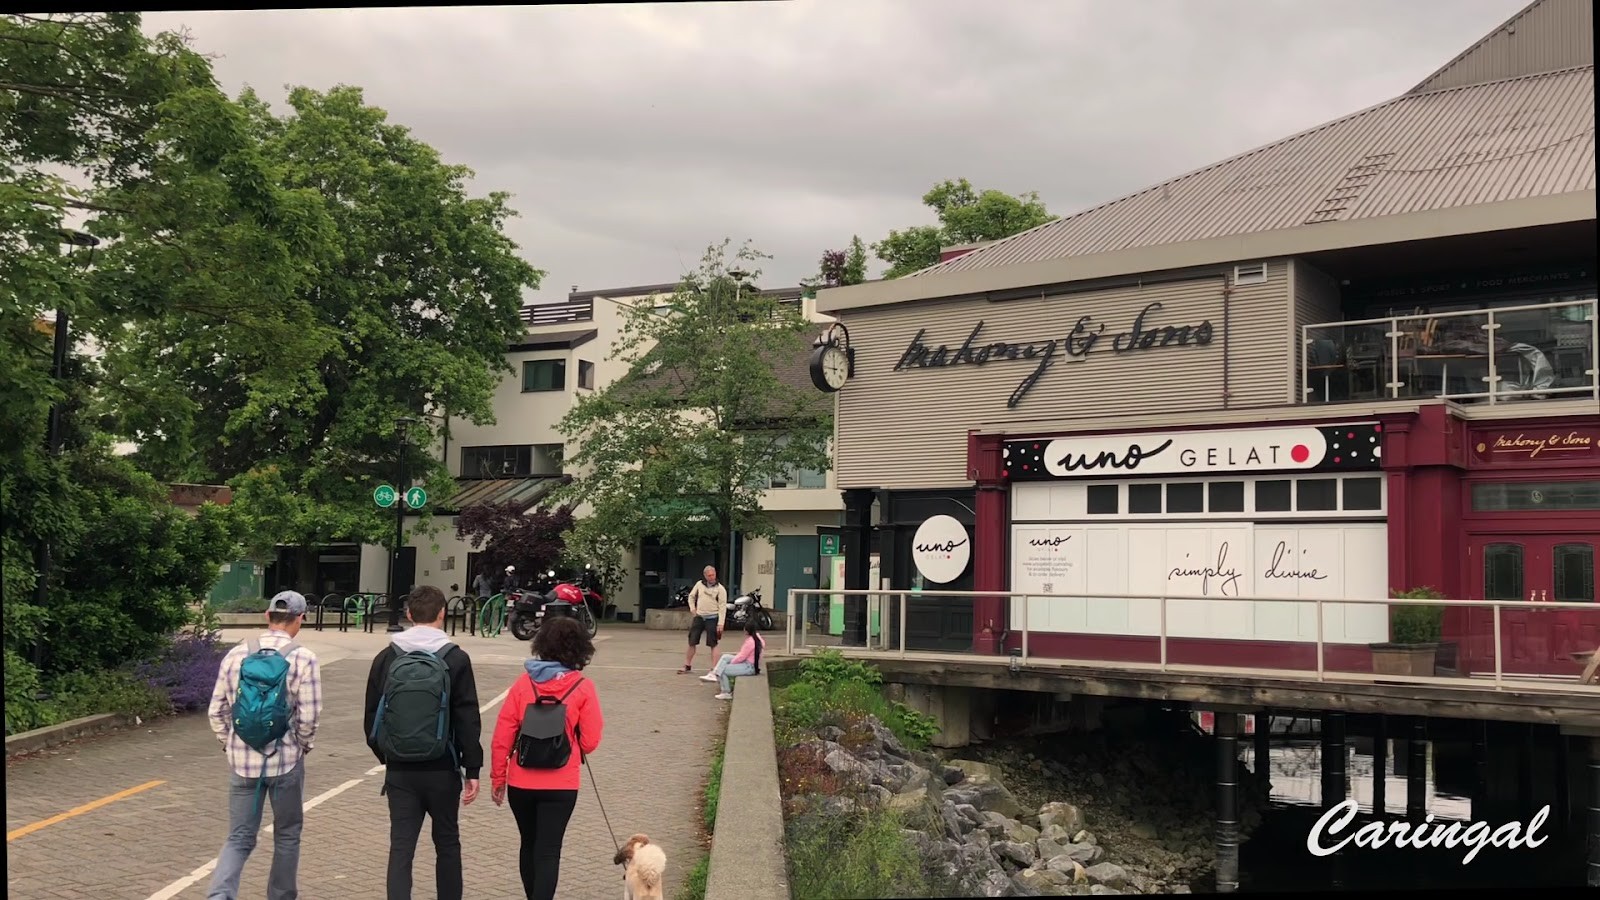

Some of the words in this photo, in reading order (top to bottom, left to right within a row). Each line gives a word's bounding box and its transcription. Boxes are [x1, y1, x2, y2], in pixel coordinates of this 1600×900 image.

[1476, 279, 1504, 288] FOOD
[1508, 272, 1570, 285] MERCHANTS
[1113, 302, 1214, 350] Sons
[1548, 434, 1561, 446] &
[1562, 431, 1591, 445] Sons
[1057, 438, 1173, 472] uno
[916, 538, 967, 552] uno
[1029, 535, 1072, 547] uno
[1168, 541, 1242, 597] simply
[1264, 541, 1328, 580] divine
